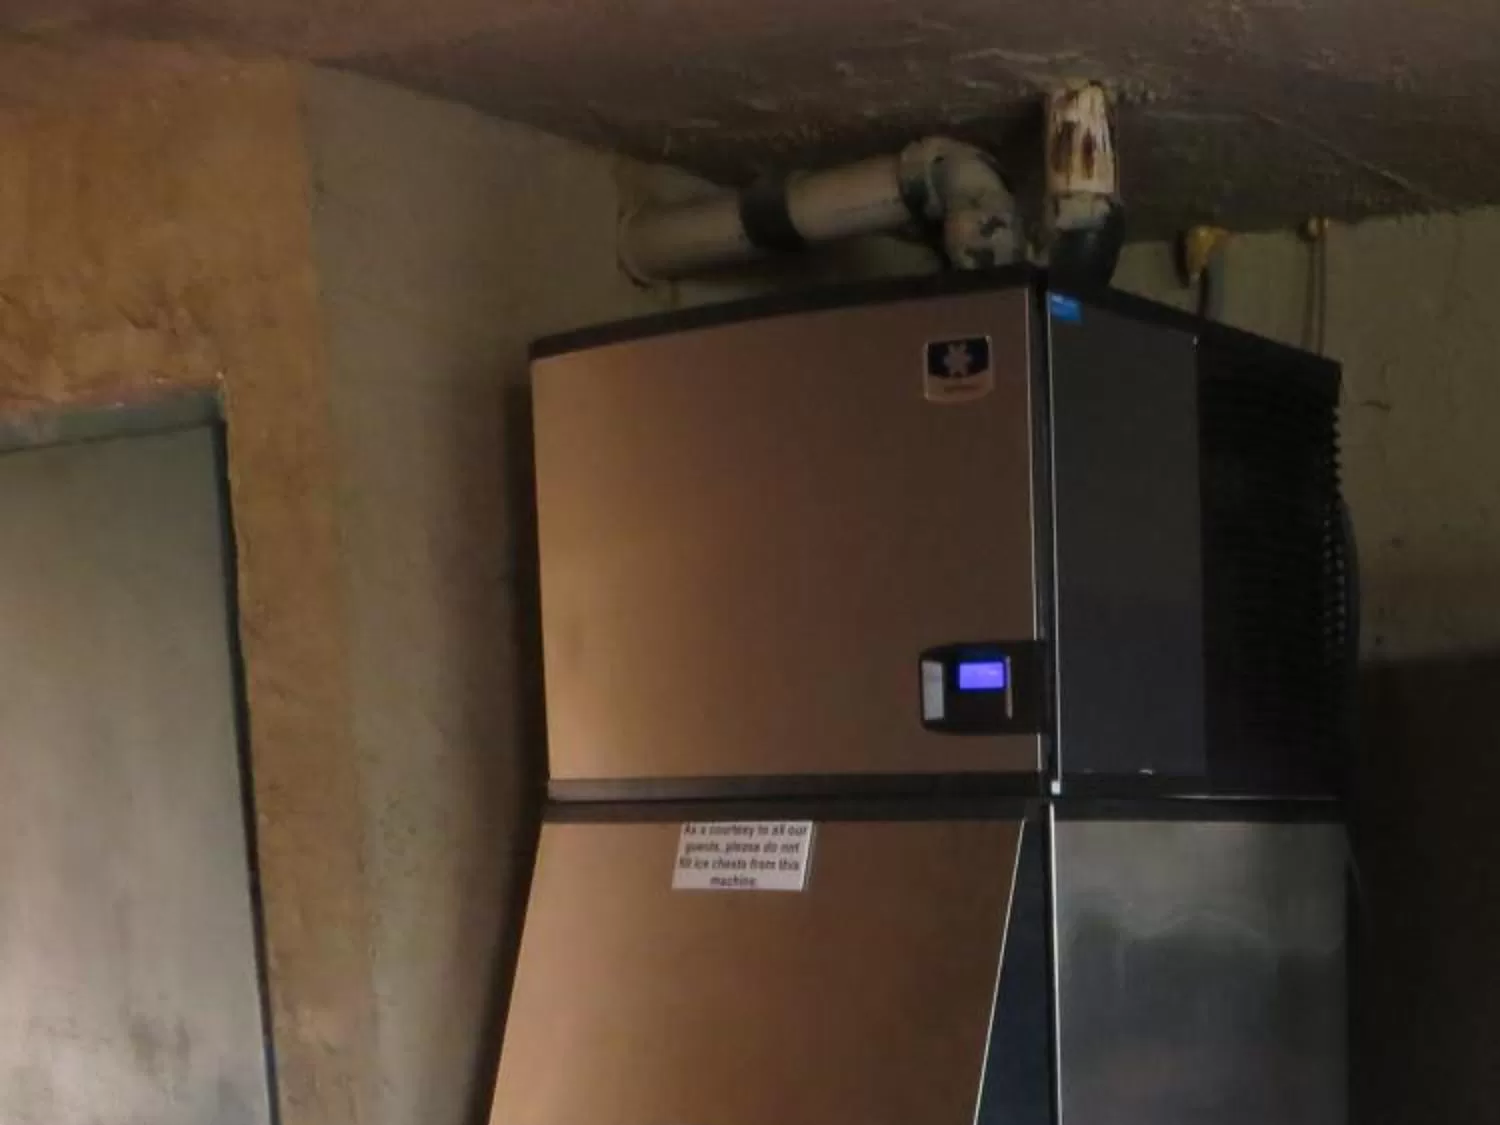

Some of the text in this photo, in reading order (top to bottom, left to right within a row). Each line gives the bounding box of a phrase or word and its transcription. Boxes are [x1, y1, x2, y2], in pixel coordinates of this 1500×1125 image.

[709, 824, 754, 838] courtesy
[757, 825, 769, 836] to
[772, 823, 785, 836] all
[788, 825, 808, 836] our
[725, 842, 761, 854] please
[764, 842, 778, 853] do
[781, 843, 800, 853] not
[750, 858, 776, 870] from
[779, 859, 799, 871] this
